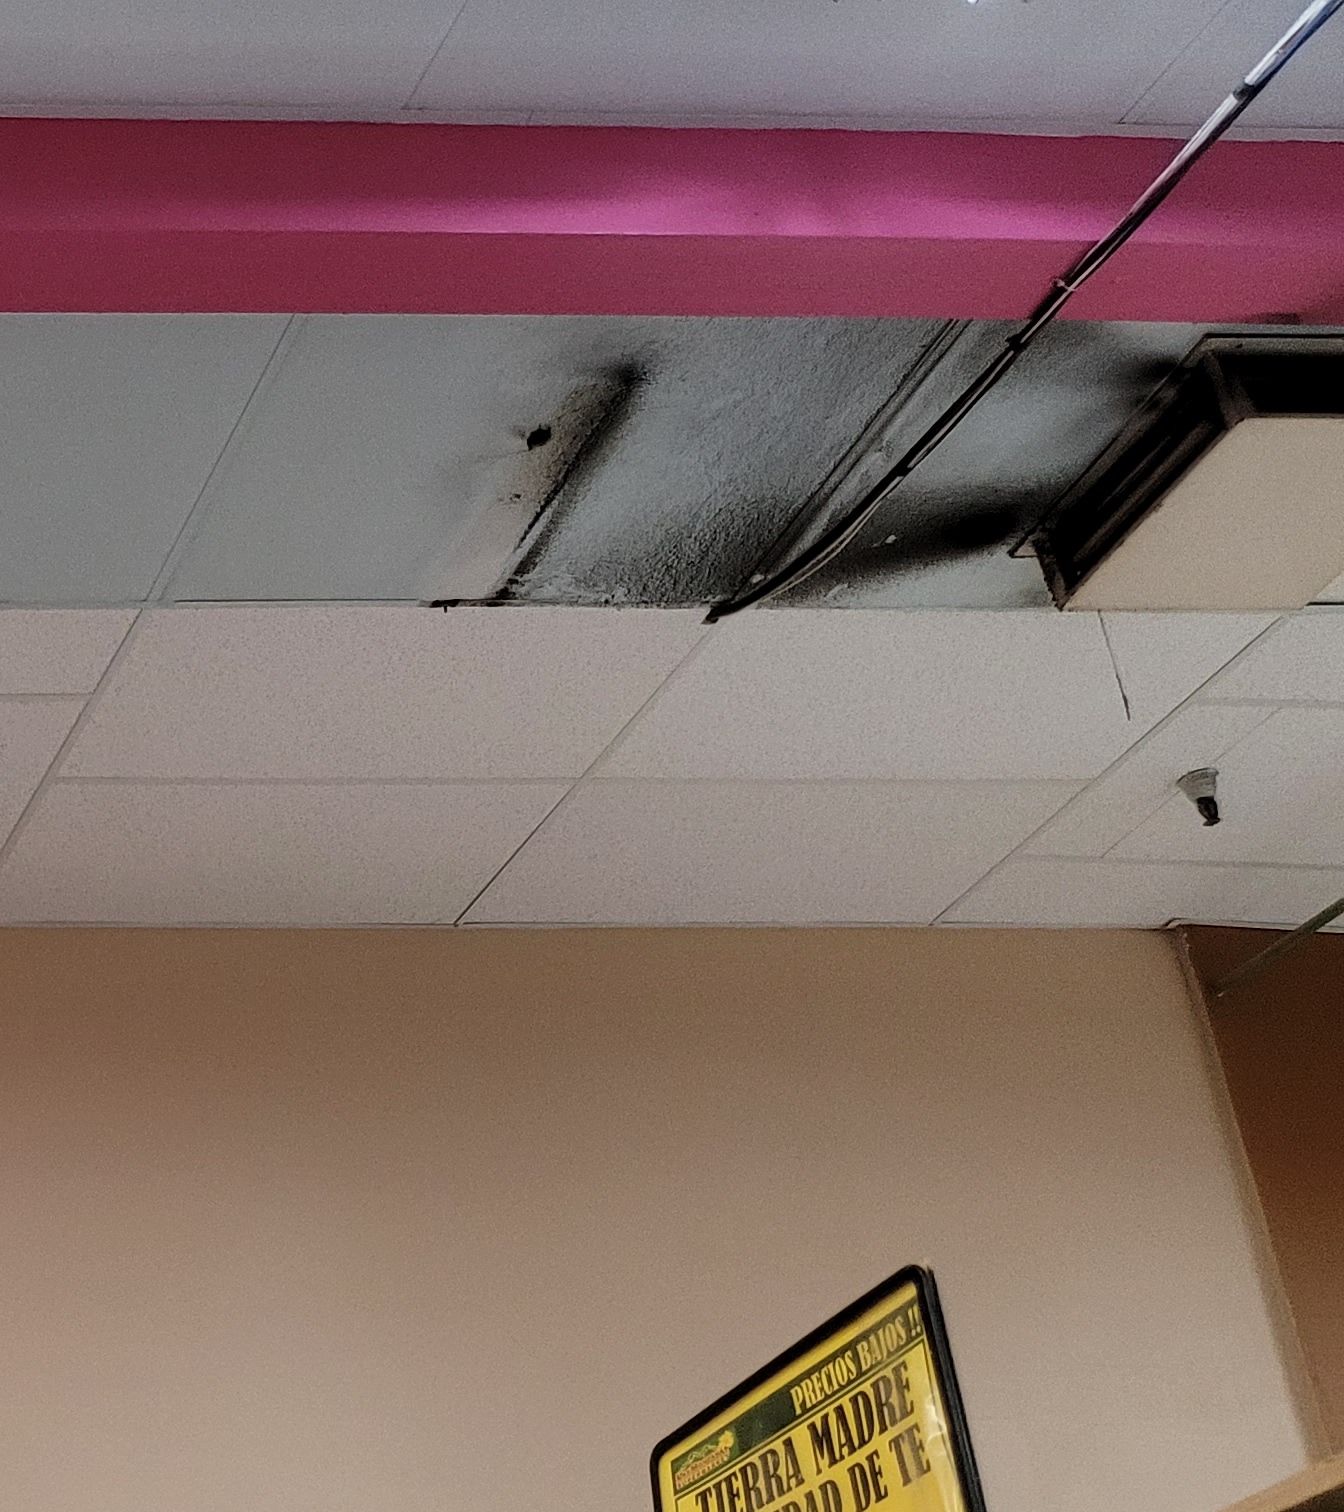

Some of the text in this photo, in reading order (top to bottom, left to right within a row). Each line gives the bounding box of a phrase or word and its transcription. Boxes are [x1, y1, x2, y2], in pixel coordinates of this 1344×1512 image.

[791, 1350, 858, 1417] PRECIOS
[857, 1317, 908, 1375] BAJOS
[806, 1360, 915, 1477] MADRE
[888, 1421, 932, 1491] TE
